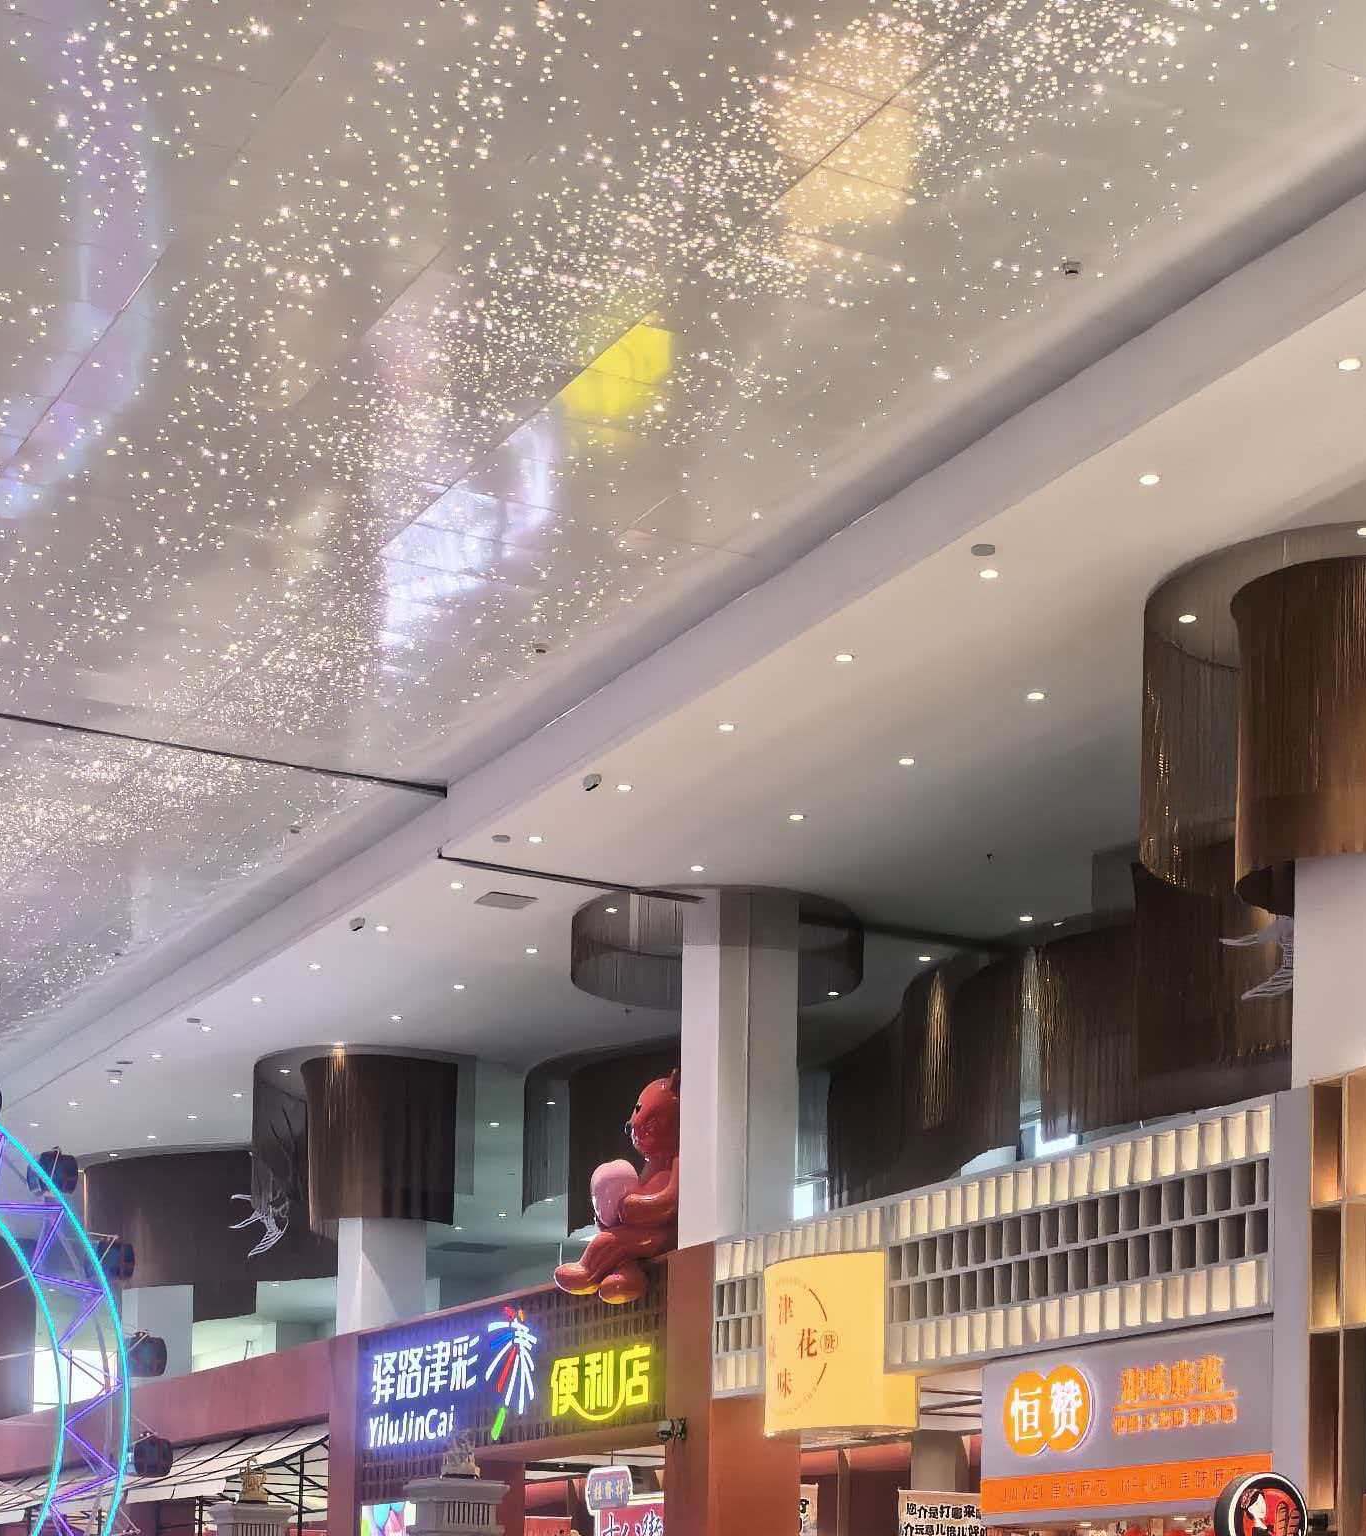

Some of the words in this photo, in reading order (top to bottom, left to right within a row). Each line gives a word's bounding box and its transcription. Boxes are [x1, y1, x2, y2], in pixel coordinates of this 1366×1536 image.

[372, 1335, 480, 1404] 驿路津彩
[550, 1343, 651, 1421] 便利店
[1010, 1378, 1084, 1443] 恒赞
[368, 1405, 455, 1448] YiluJinCai
